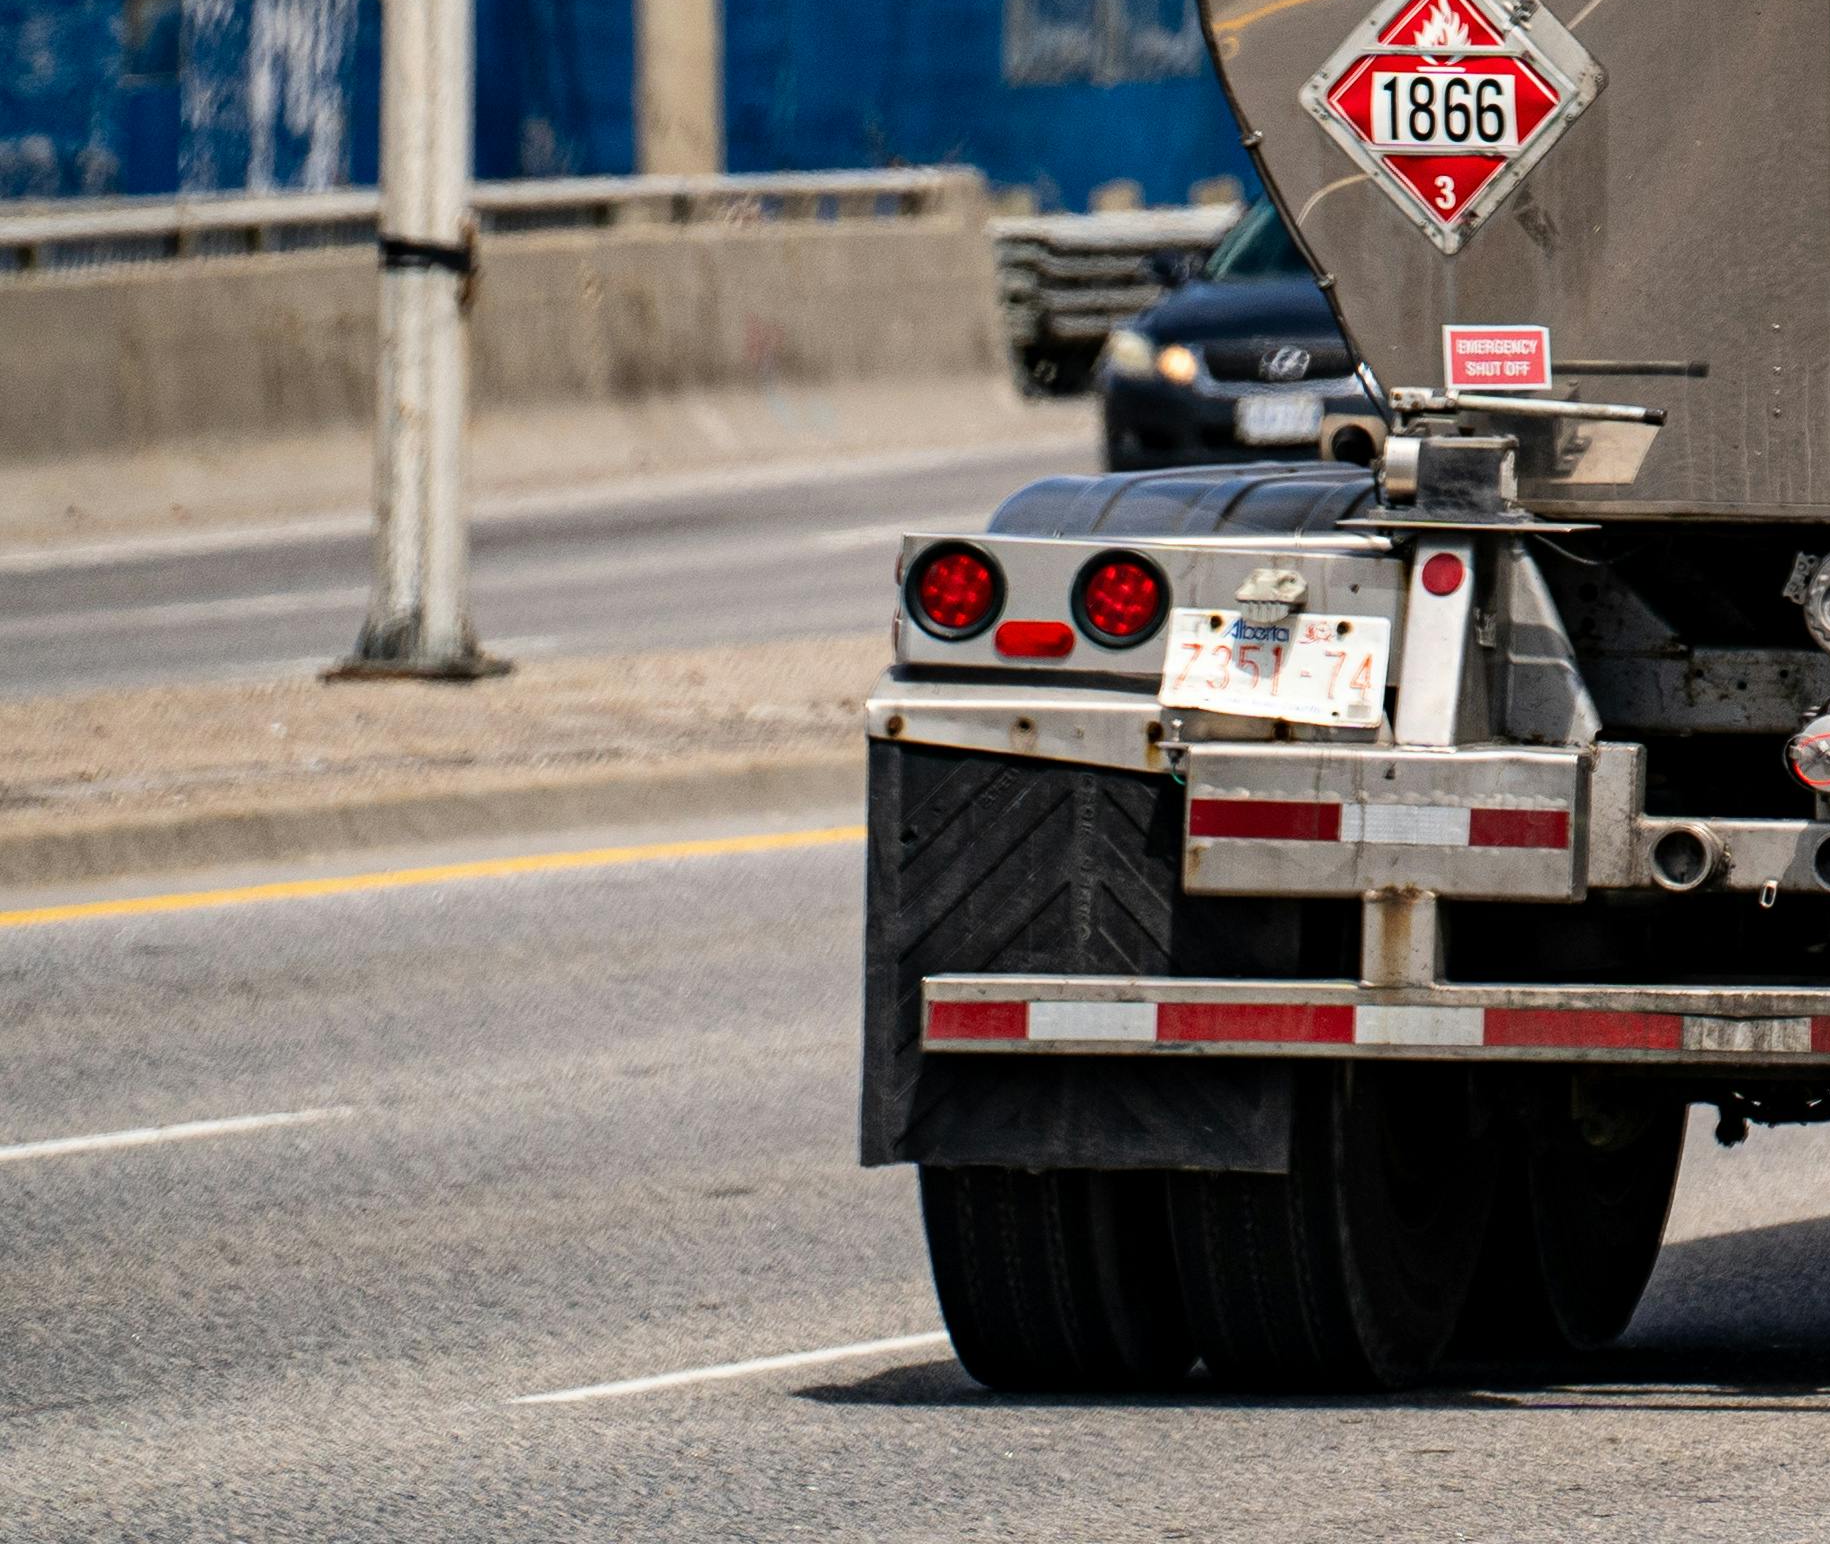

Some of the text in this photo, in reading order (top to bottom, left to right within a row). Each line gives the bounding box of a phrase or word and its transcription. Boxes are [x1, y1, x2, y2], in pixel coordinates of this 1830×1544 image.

[1383, 76, 1505, 143] 1866
[1434, 175, 1456, 210] 3
[1455, 338, 1538, 355] EMERGENCY
[1464, 360, 1531, 376] SHUT OFF
[1222, 617, 1290, 643] Alberta
